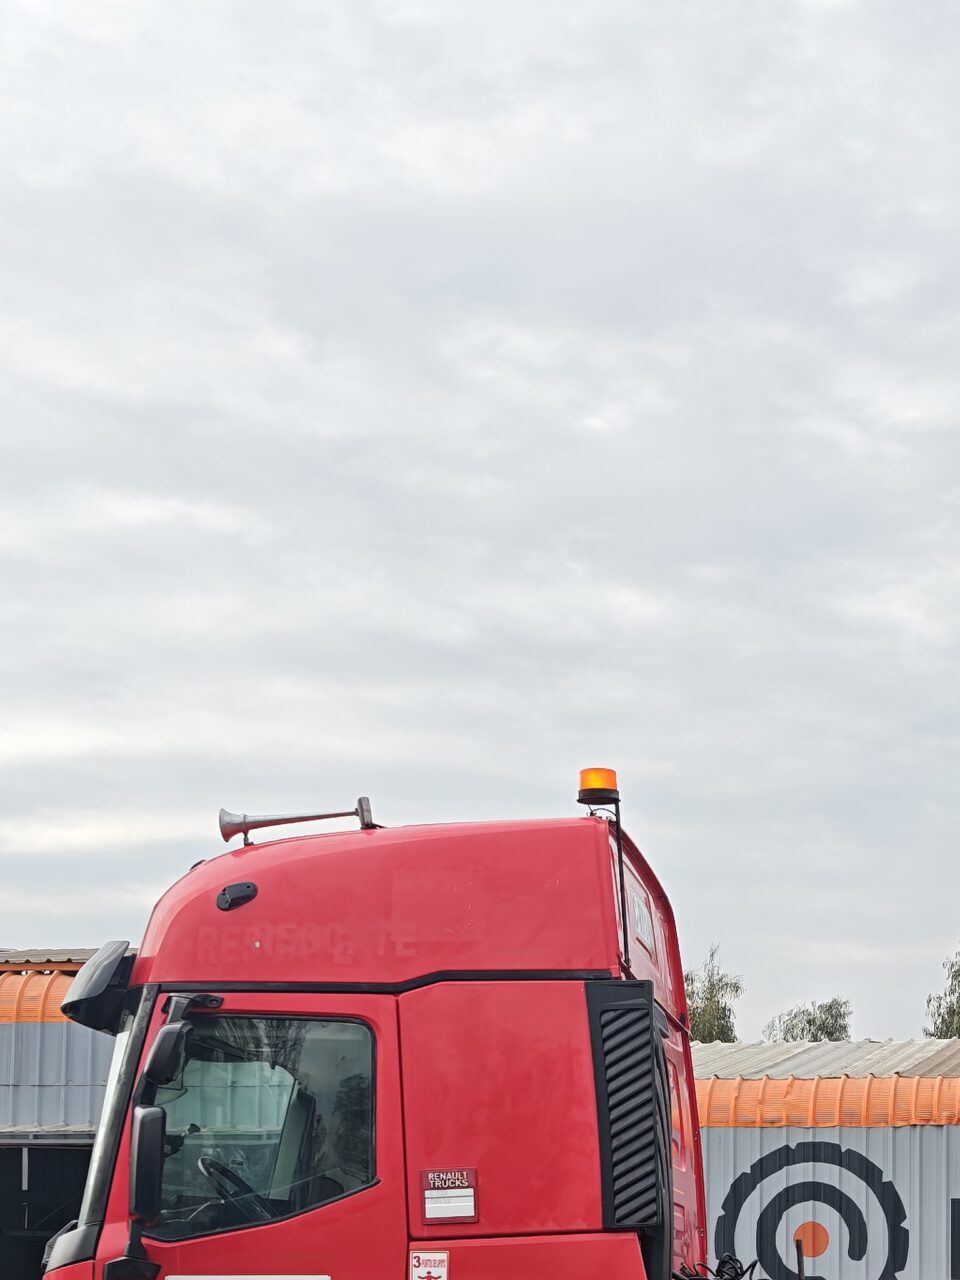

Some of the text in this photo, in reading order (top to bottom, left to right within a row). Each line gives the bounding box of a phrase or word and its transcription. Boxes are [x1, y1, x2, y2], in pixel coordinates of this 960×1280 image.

[428, 1171, 468, 1181] RENAULT
[429, 1179, 469, 1188] TRUCKS
[413, 1255, 421, 1268] 3
